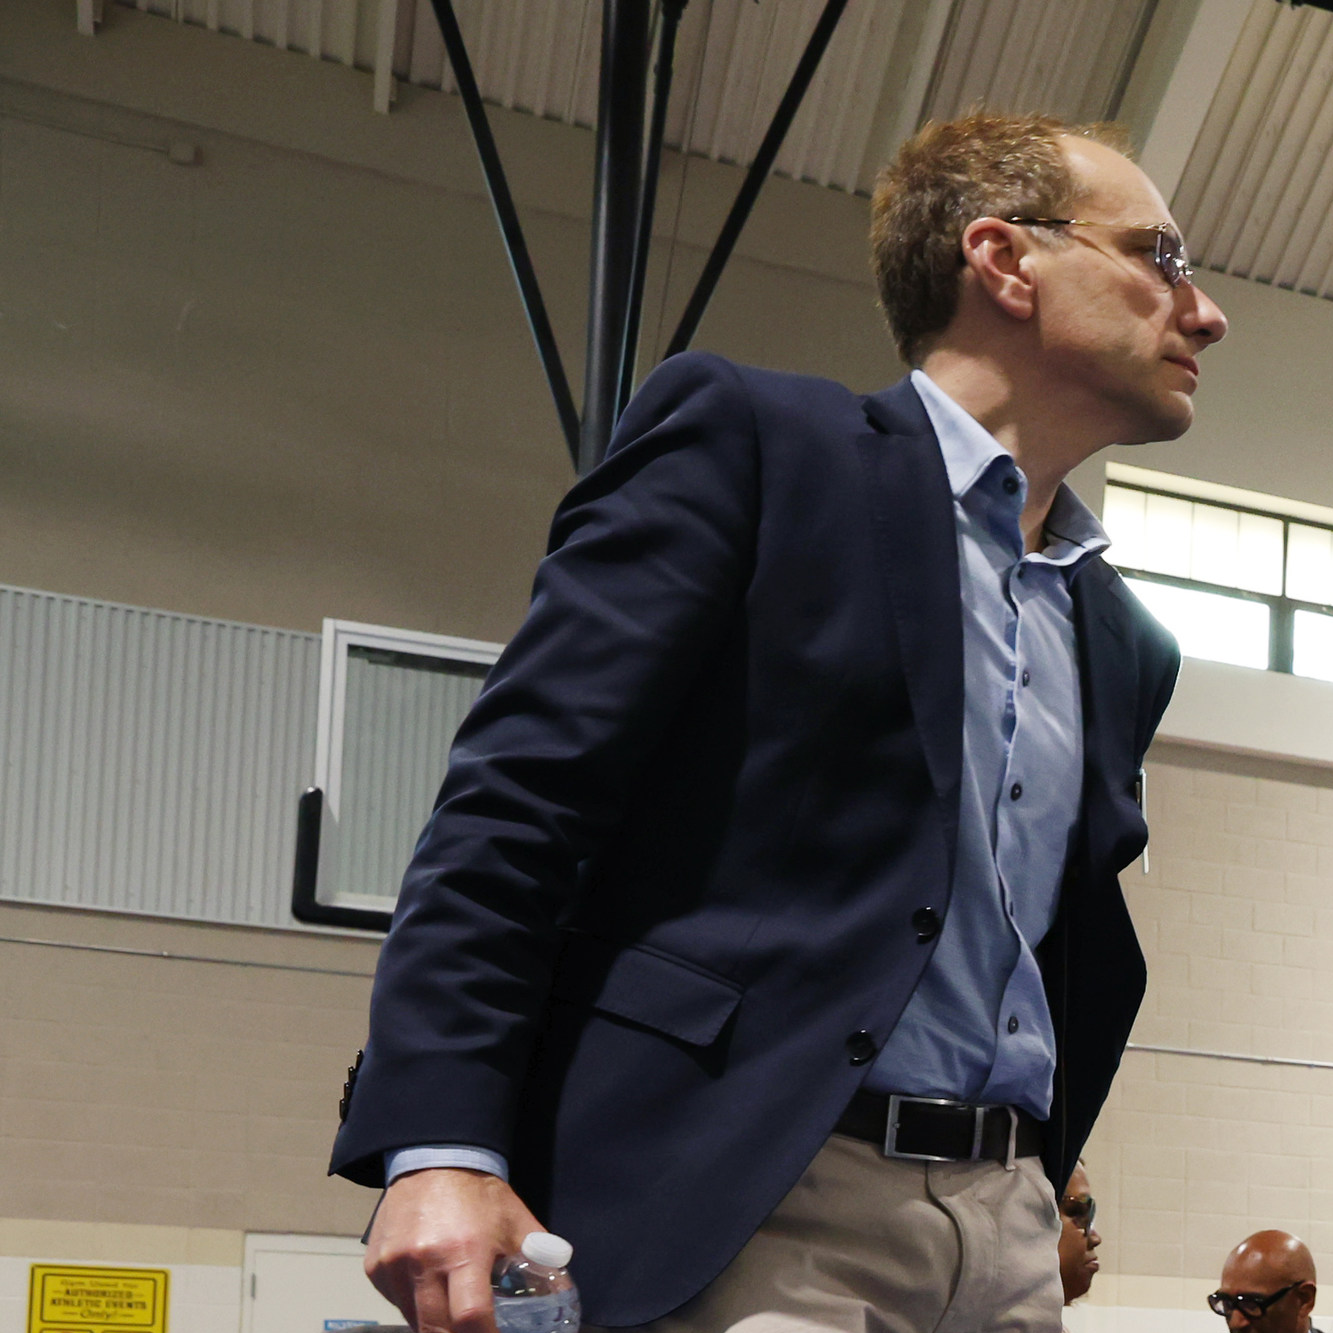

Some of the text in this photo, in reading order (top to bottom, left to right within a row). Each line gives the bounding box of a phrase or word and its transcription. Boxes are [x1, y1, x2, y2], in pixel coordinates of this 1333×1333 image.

[65, 1289, 133, 1299] AUTHORIZED
[51, 1298, 147, 1310] ATHLETIC EVENTS
